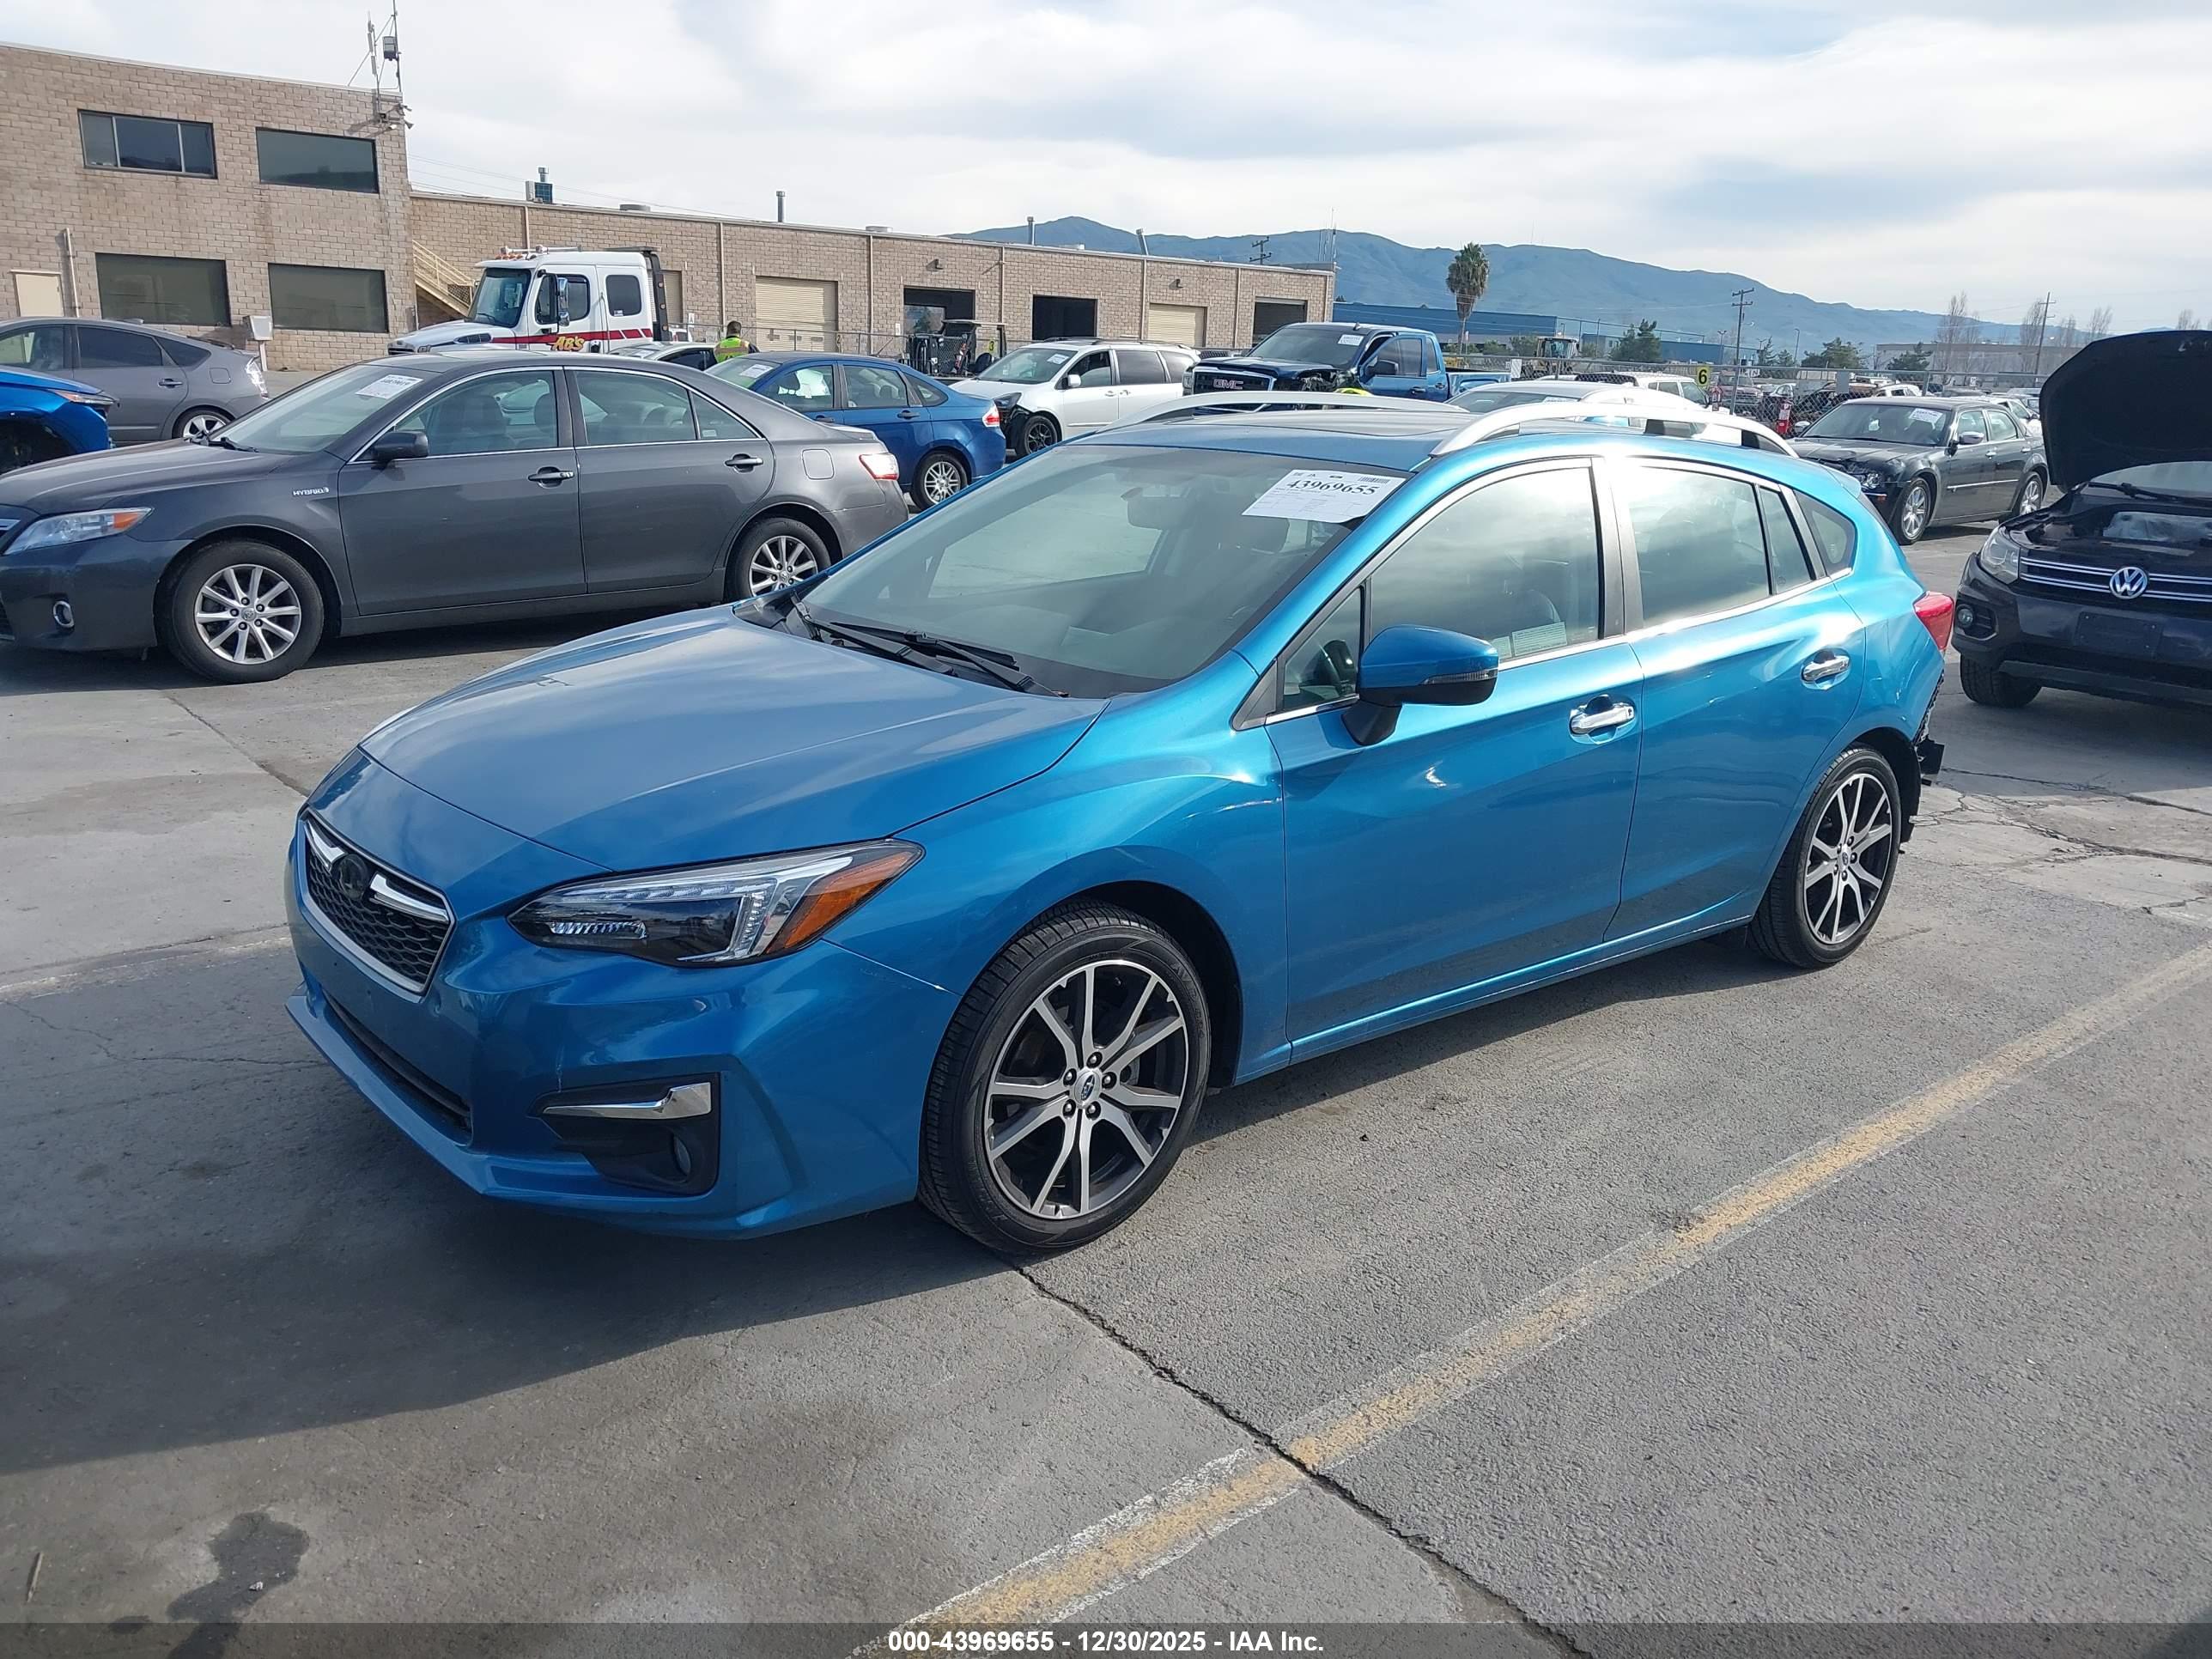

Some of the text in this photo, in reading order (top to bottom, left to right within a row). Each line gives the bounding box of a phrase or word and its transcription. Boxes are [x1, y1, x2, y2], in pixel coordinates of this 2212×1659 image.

[989, 340, 994, 350] 3
[1698, 369, 1707, 385] 6
[1213, 379, 1243, 390] GMC
[1287, 479, 1381, 495] 43969655
